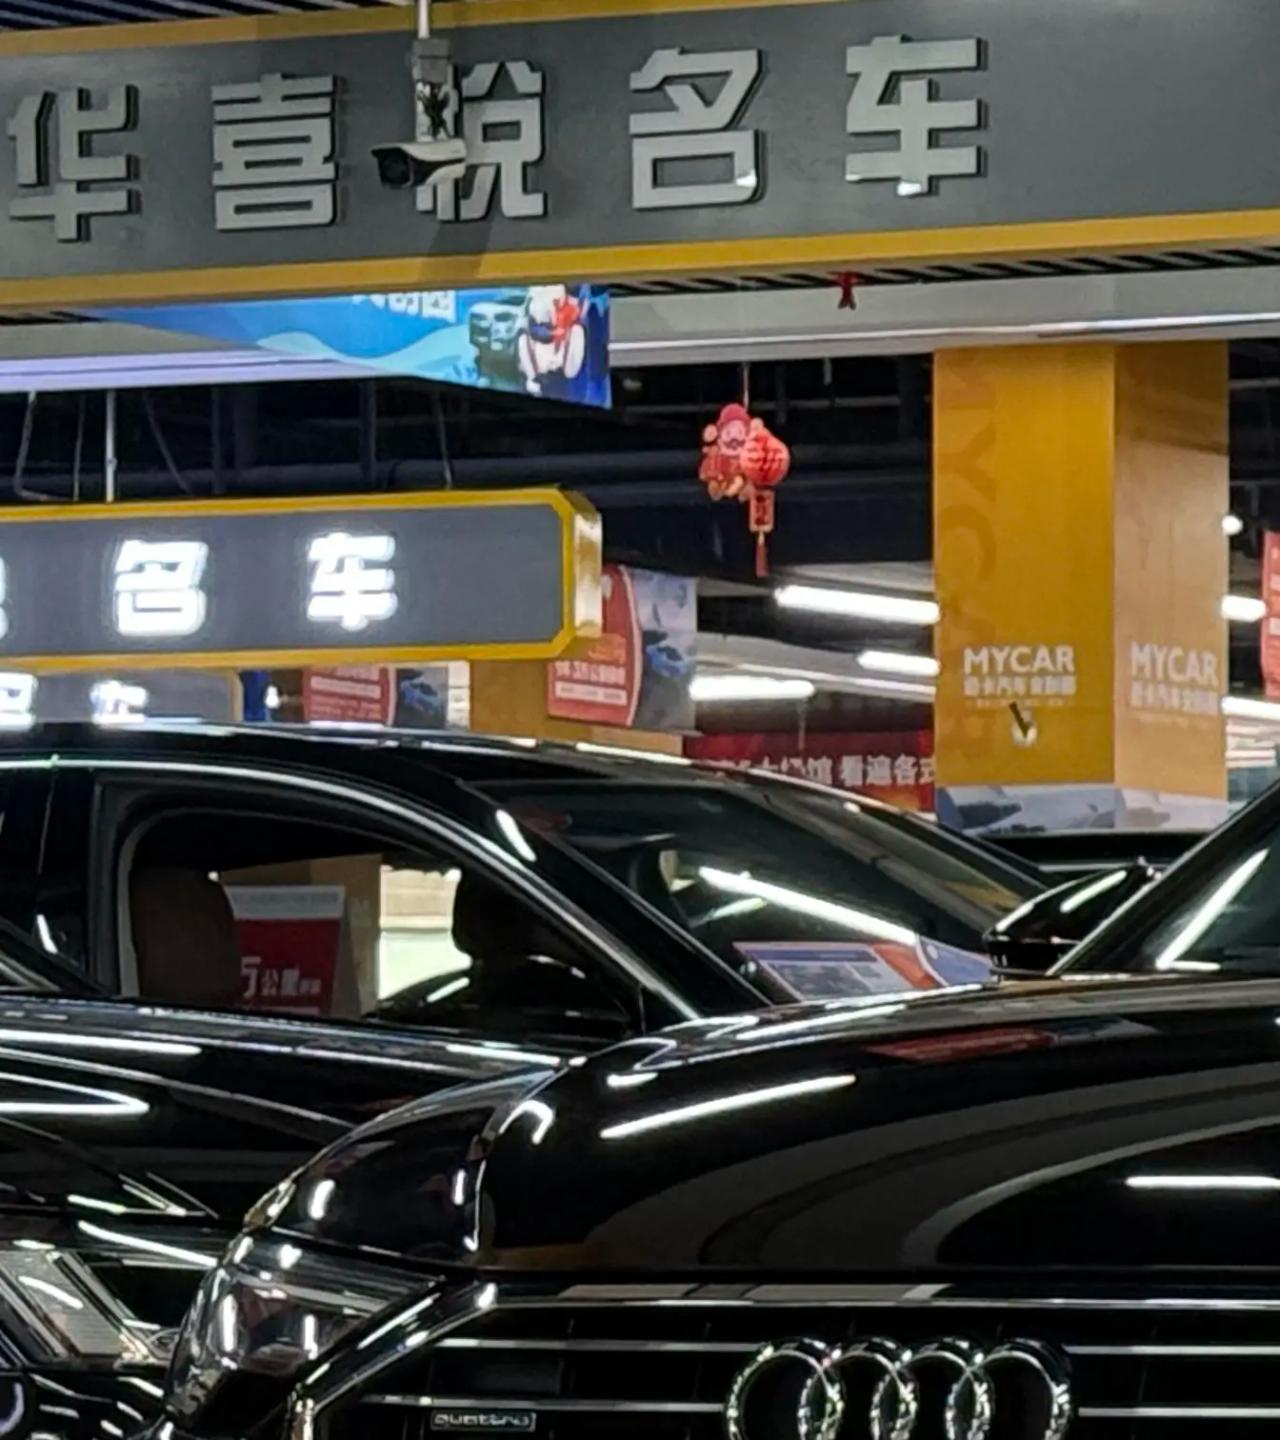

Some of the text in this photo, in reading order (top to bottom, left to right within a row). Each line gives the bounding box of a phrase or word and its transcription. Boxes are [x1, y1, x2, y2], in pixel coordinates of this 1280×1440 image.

[6, 34, 986, 242] 华喜悦名车
[963, 644, 1076, 675] MYCAR
[1130, 640, 1219, 690] MYCAR
